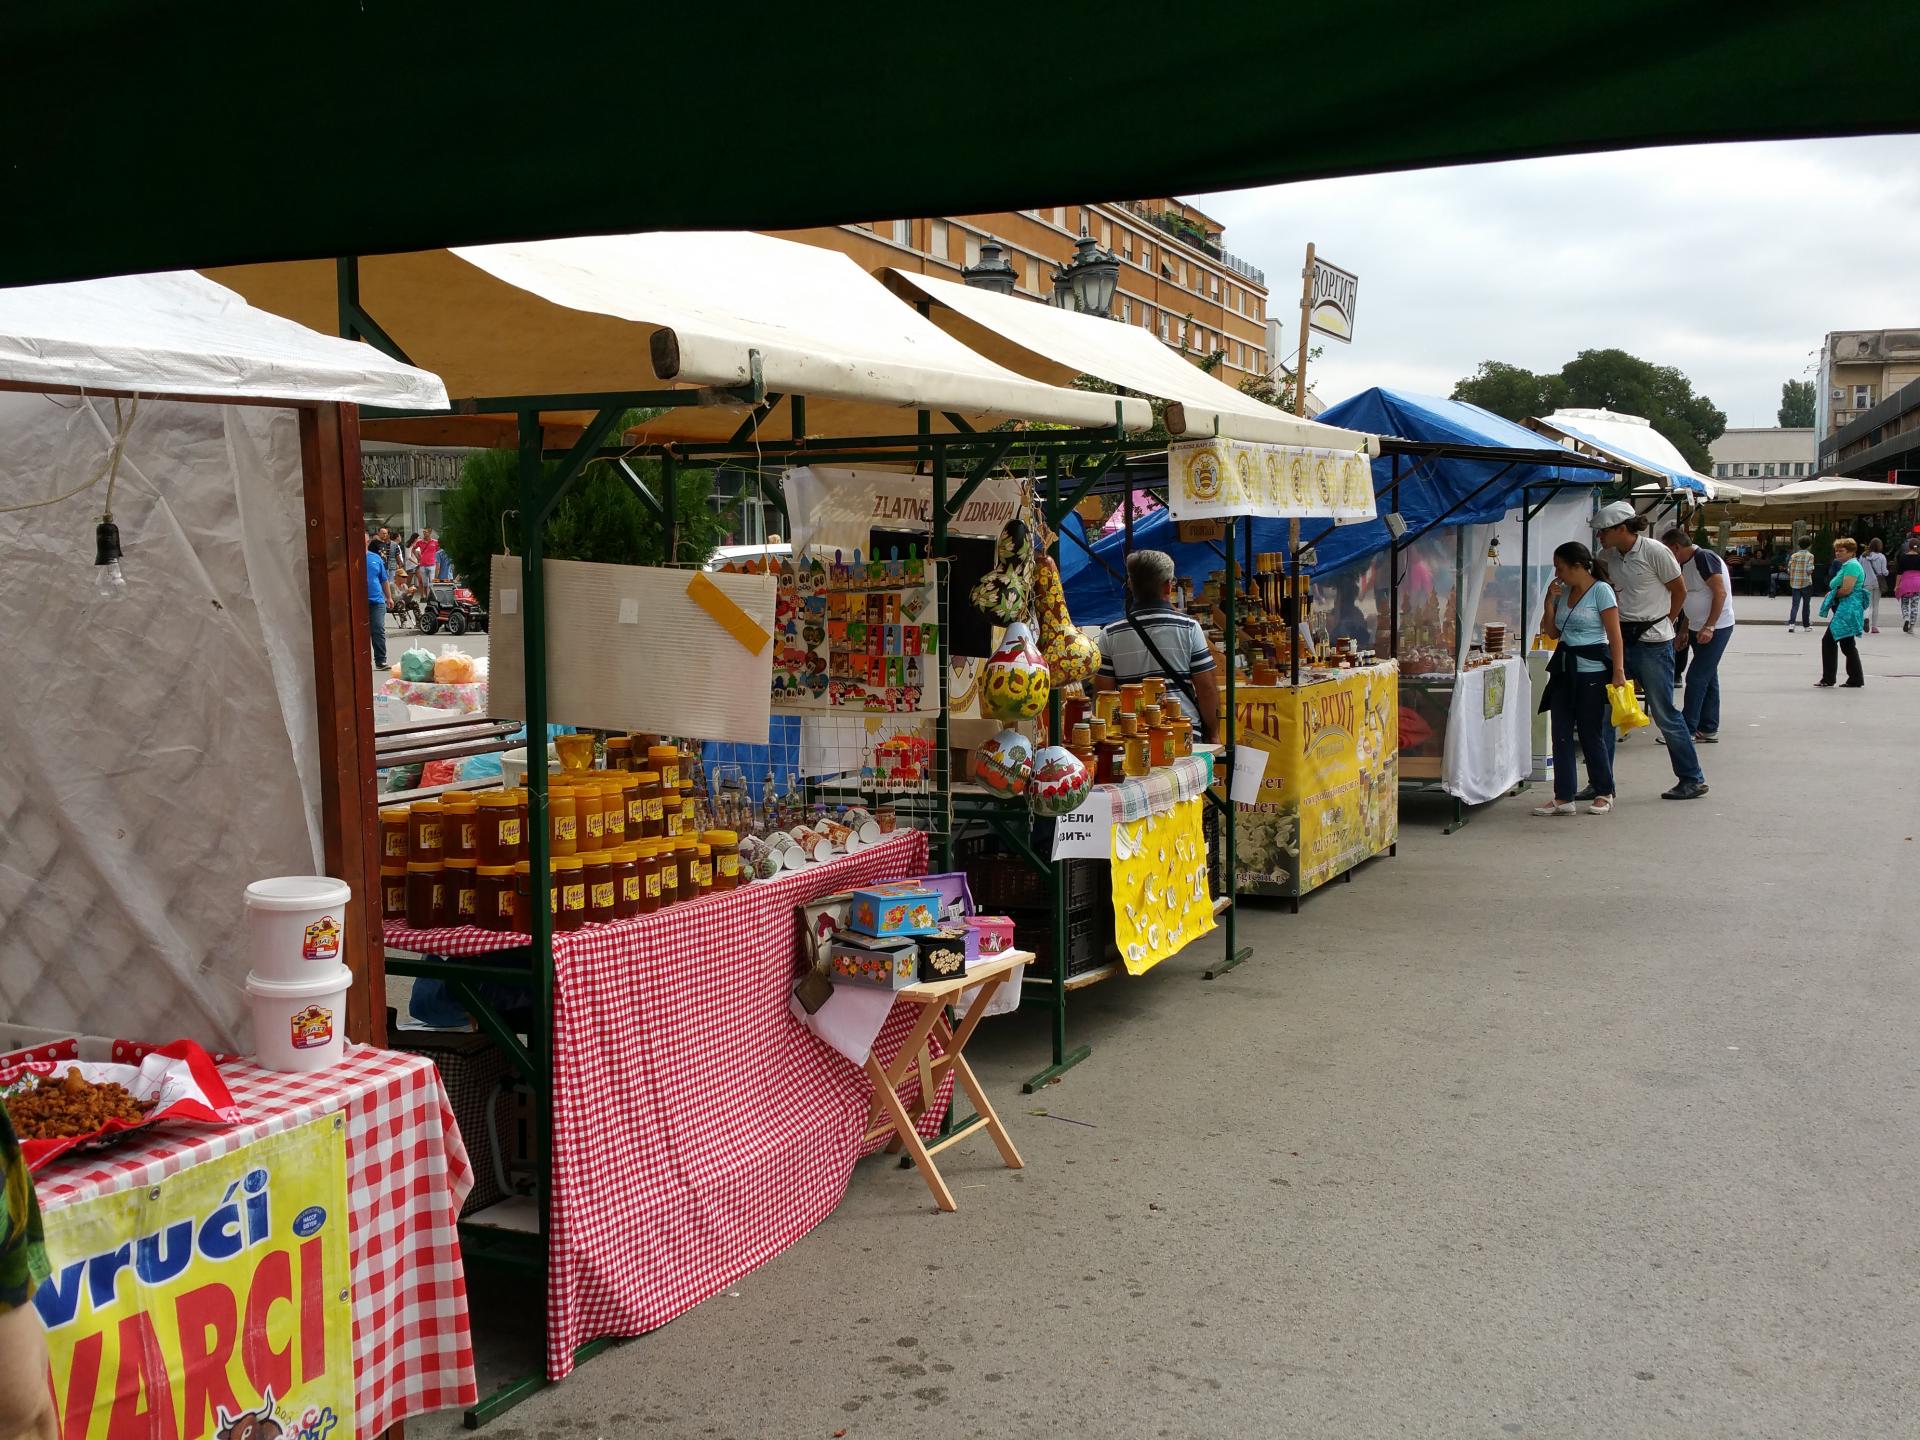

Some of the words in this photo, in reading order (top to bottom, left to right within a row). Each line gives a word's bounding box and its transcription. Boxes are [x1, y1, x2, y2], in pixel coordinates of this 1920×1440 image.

[963, 501, 1015, 525] ZDRAVLJA
[33, 1169, 270, 1328] vrući
[47, 1237, 326, 1440] VARCI
